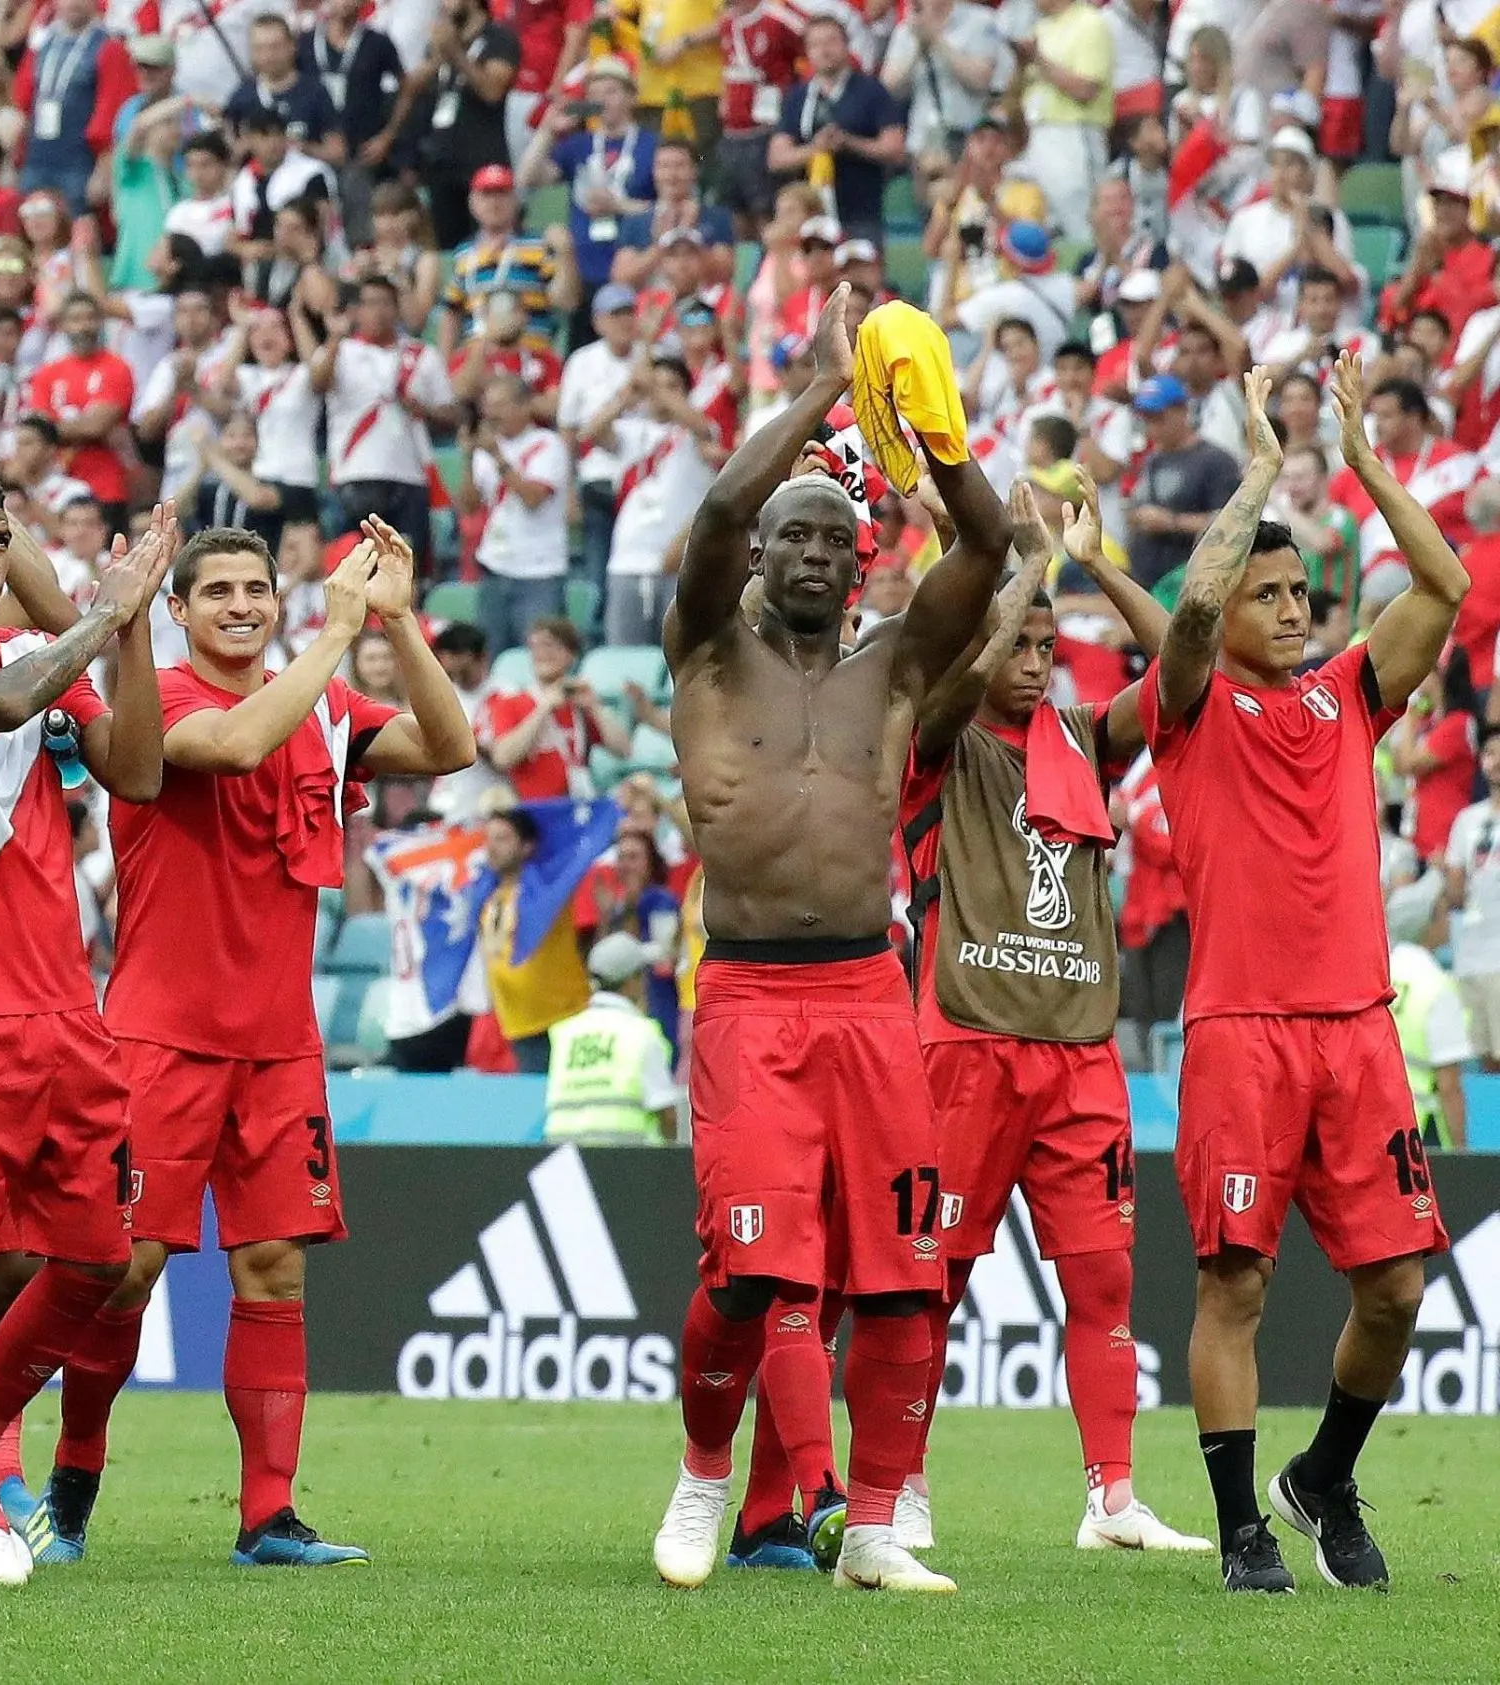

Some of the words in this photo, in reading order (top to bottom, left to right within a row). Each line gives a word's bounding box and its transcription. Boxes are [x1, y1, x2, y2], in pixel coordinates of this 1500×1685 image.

[958, 941, 1061, 978] RUSSIA
[1062, 956, 1101, 984] 2018
[997, 932, 1025, 947] FIFA
[1025, 935, 1068, 952] WORLD
[306, 1116, 330, 1181] 3
[1099, 1139, 1134, 1201] 14
[1386, 1127, 1431, 1196] 19
[890, 1166, 940, 1236] 17
[399, 1312, 678, 1399] adidas
